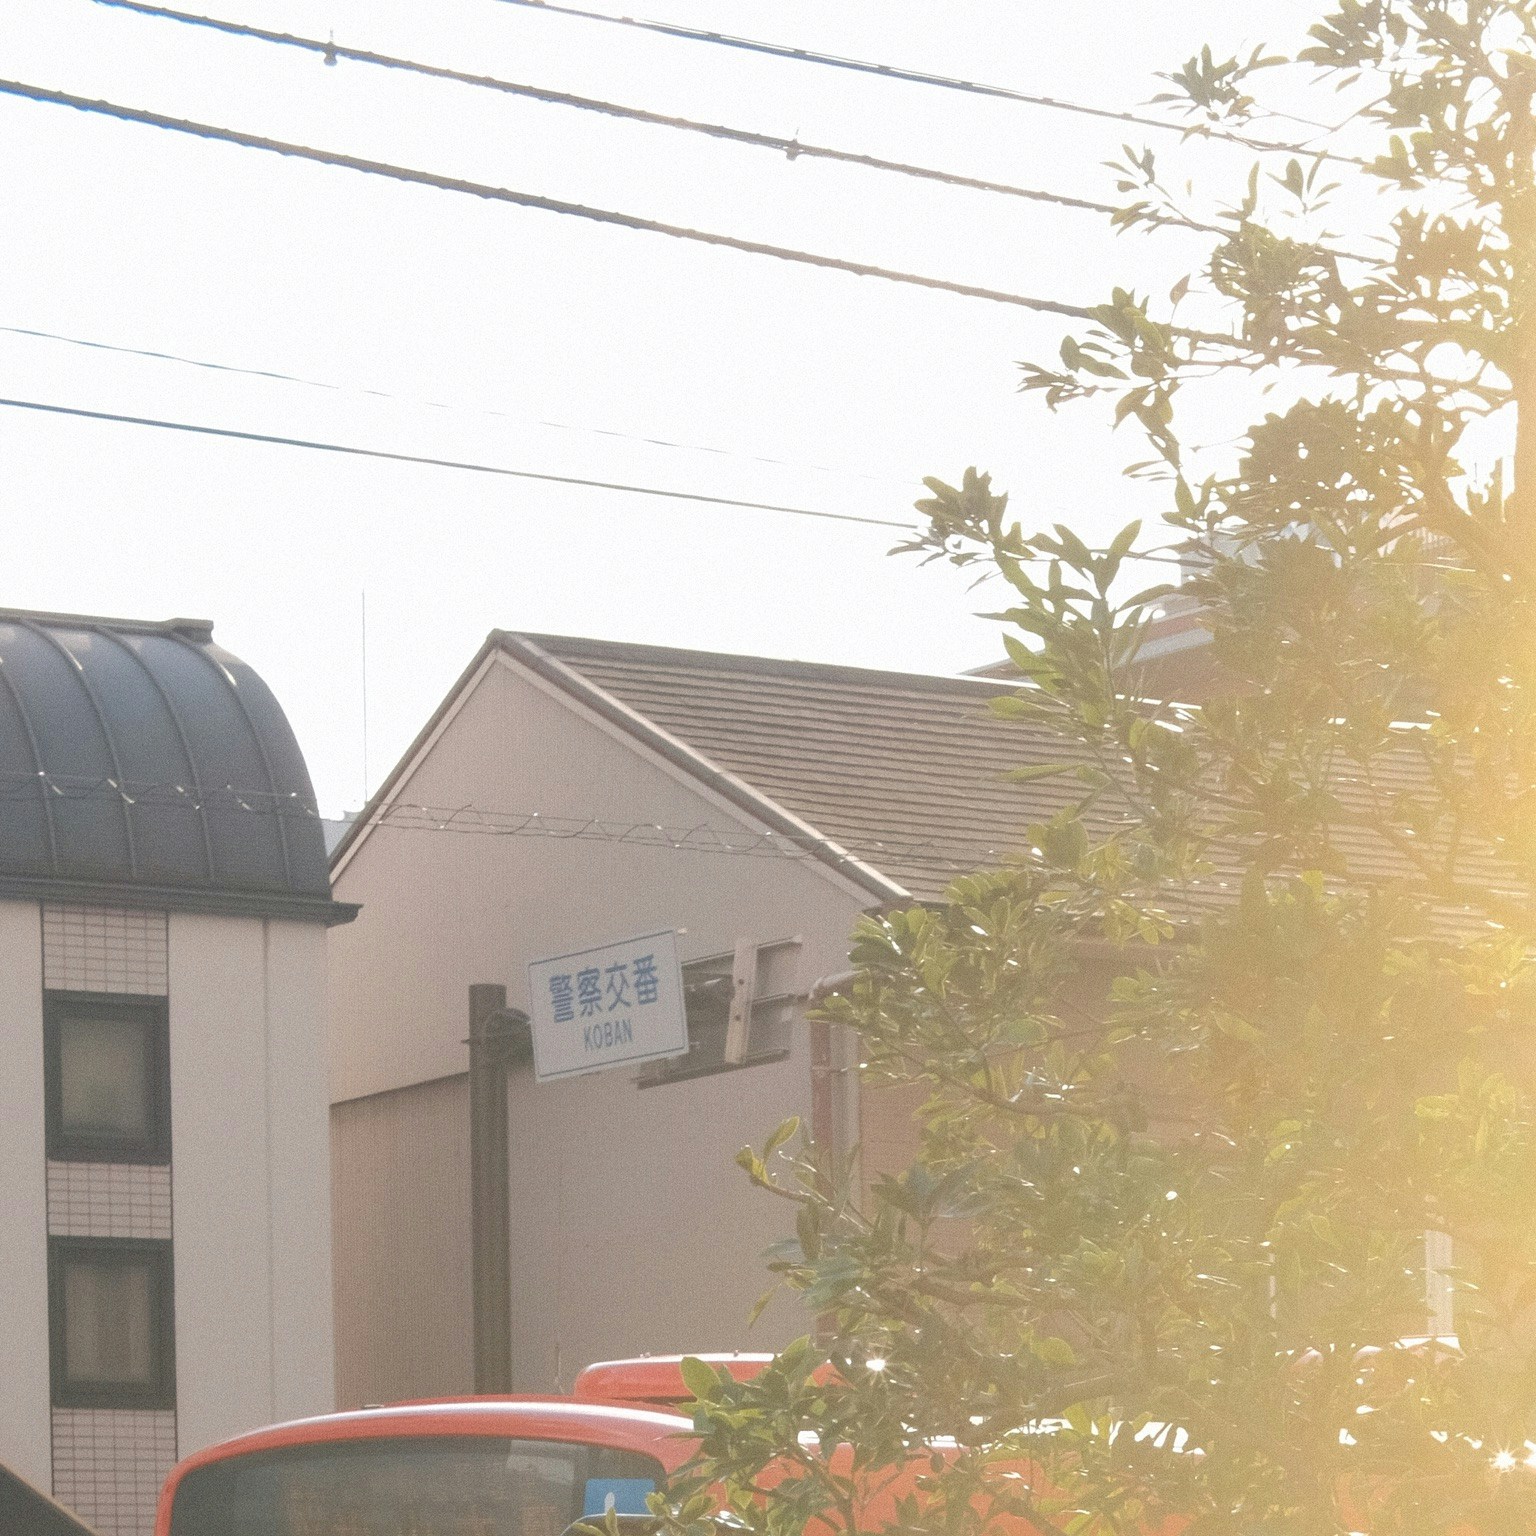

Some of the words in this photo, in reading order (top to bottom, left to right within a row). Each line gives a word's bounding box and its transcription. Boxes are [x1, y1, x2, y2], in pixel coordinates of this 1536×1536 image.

[550, 954, 658, 1024] 警察交番
[583, 1019, 633, 1052] KOBAN
